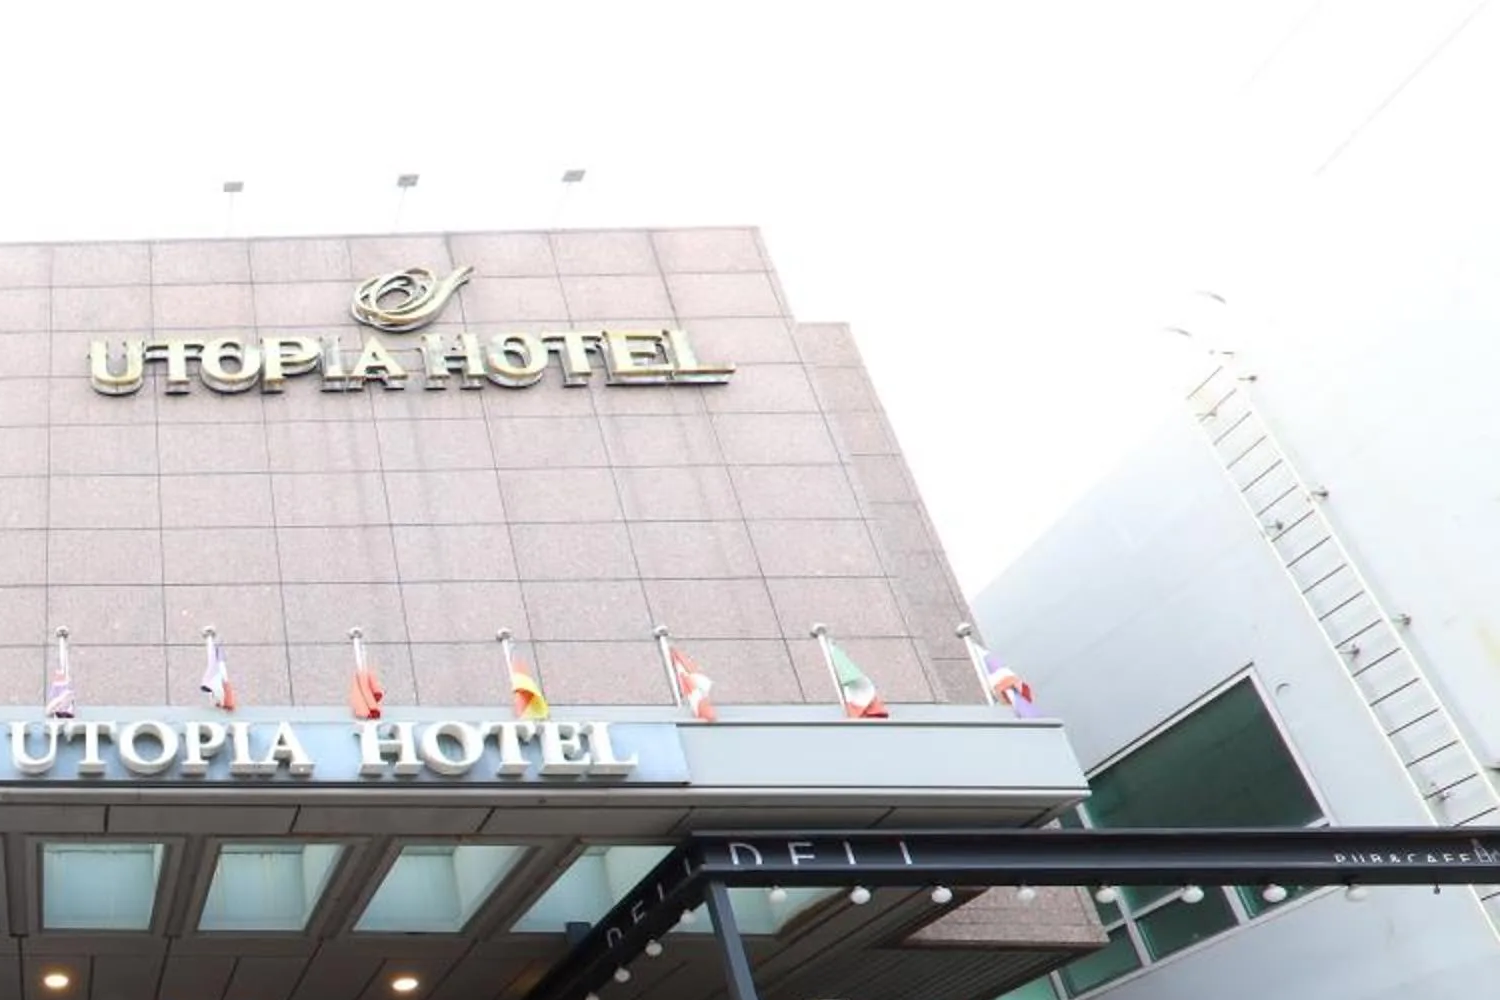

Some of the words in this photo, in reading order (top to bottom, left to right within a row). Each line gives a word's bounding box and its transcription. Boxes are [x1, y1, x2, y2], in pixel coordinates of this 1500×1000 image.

[88, 333, 408, 396] UTOPIA
[420, 329, 737, 391] HOTEL
[6, 720, 314, 778] UTOPIA
[356, 720, 639, 778] HOTEL
